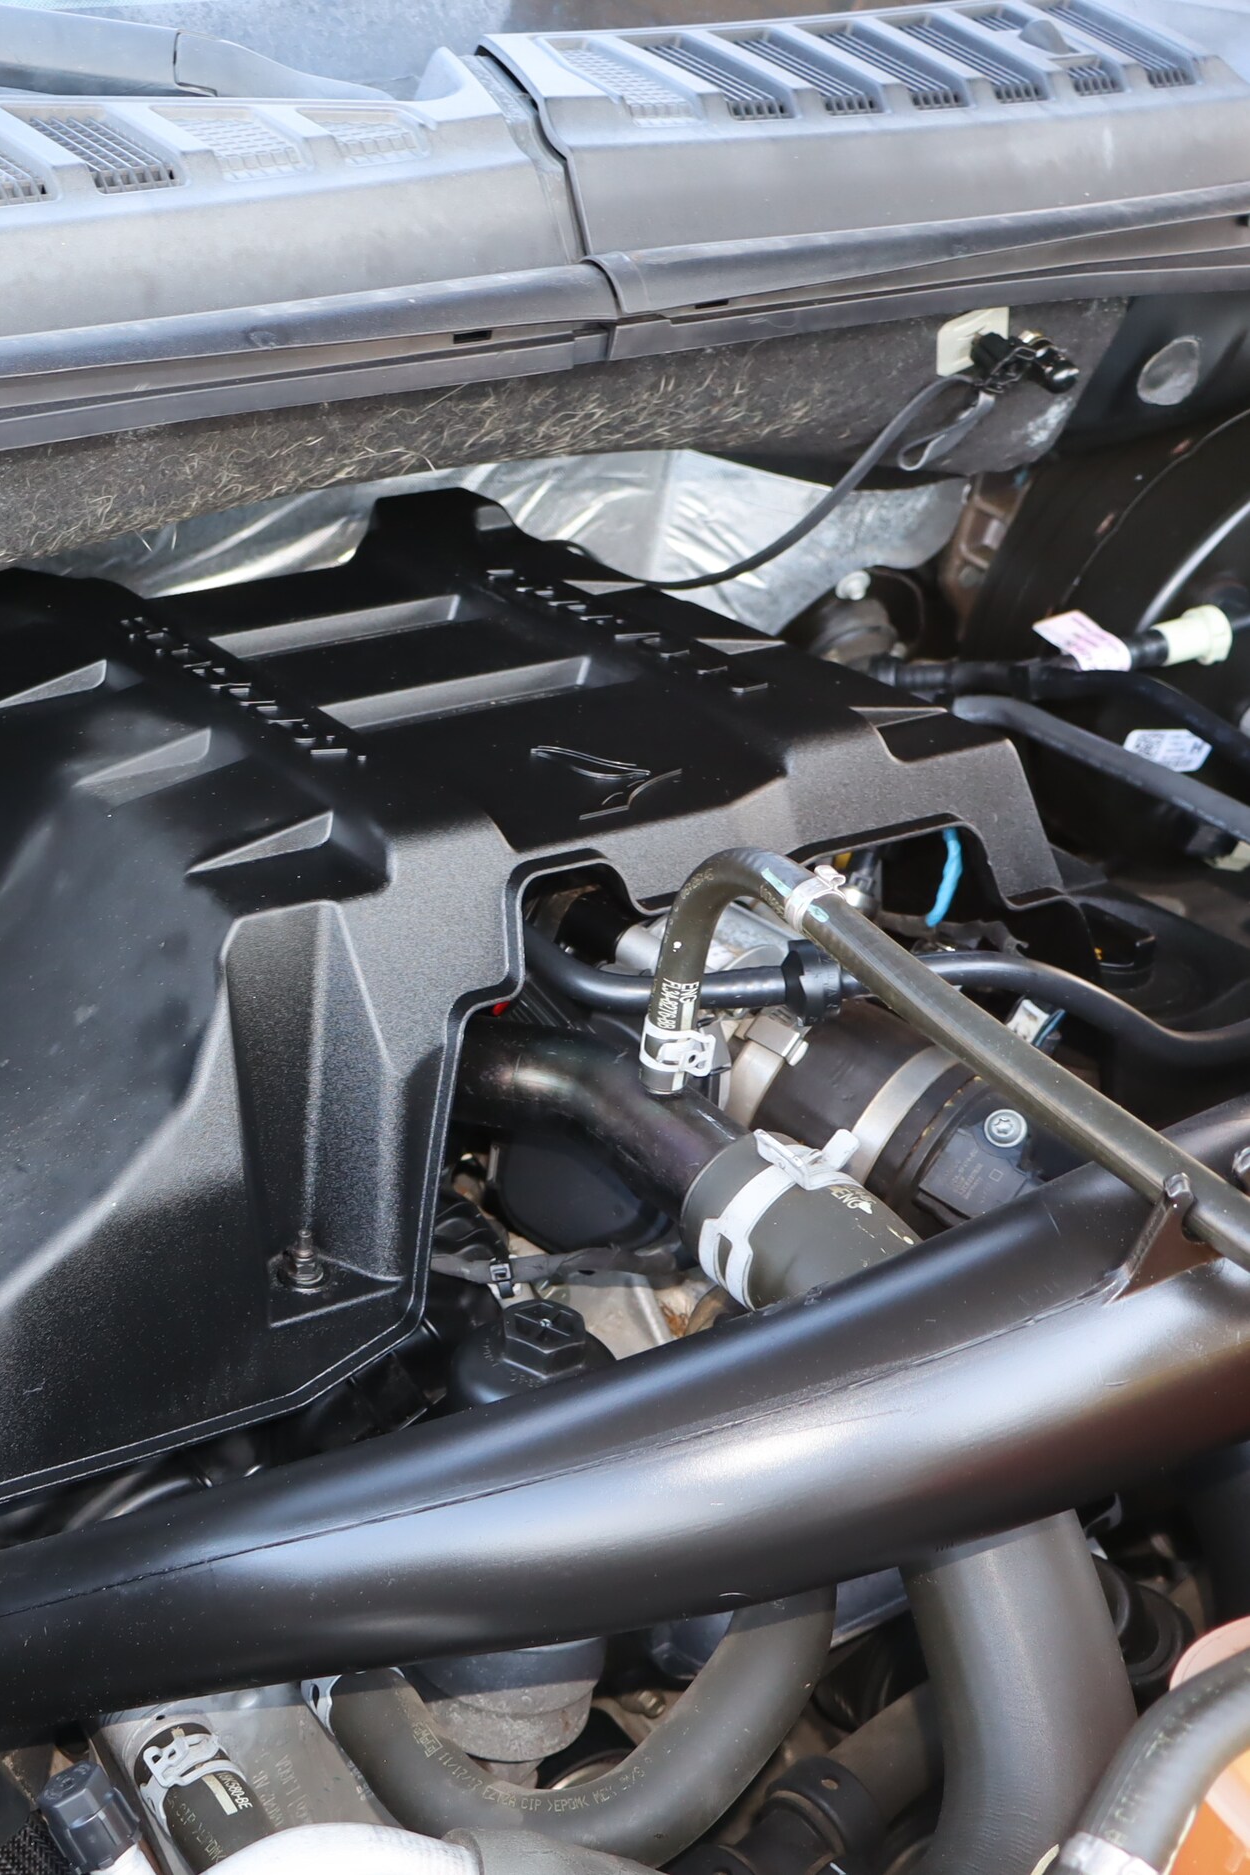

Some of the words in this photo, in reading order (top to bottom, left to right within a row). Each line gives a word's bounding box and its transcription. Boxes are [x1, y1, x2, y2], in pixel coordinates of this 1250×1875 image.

[679, 981, 700, 1003] ENG
[831, 1188, 861, 1209] ENG
[521, 1799, 542, 1812] CIP
